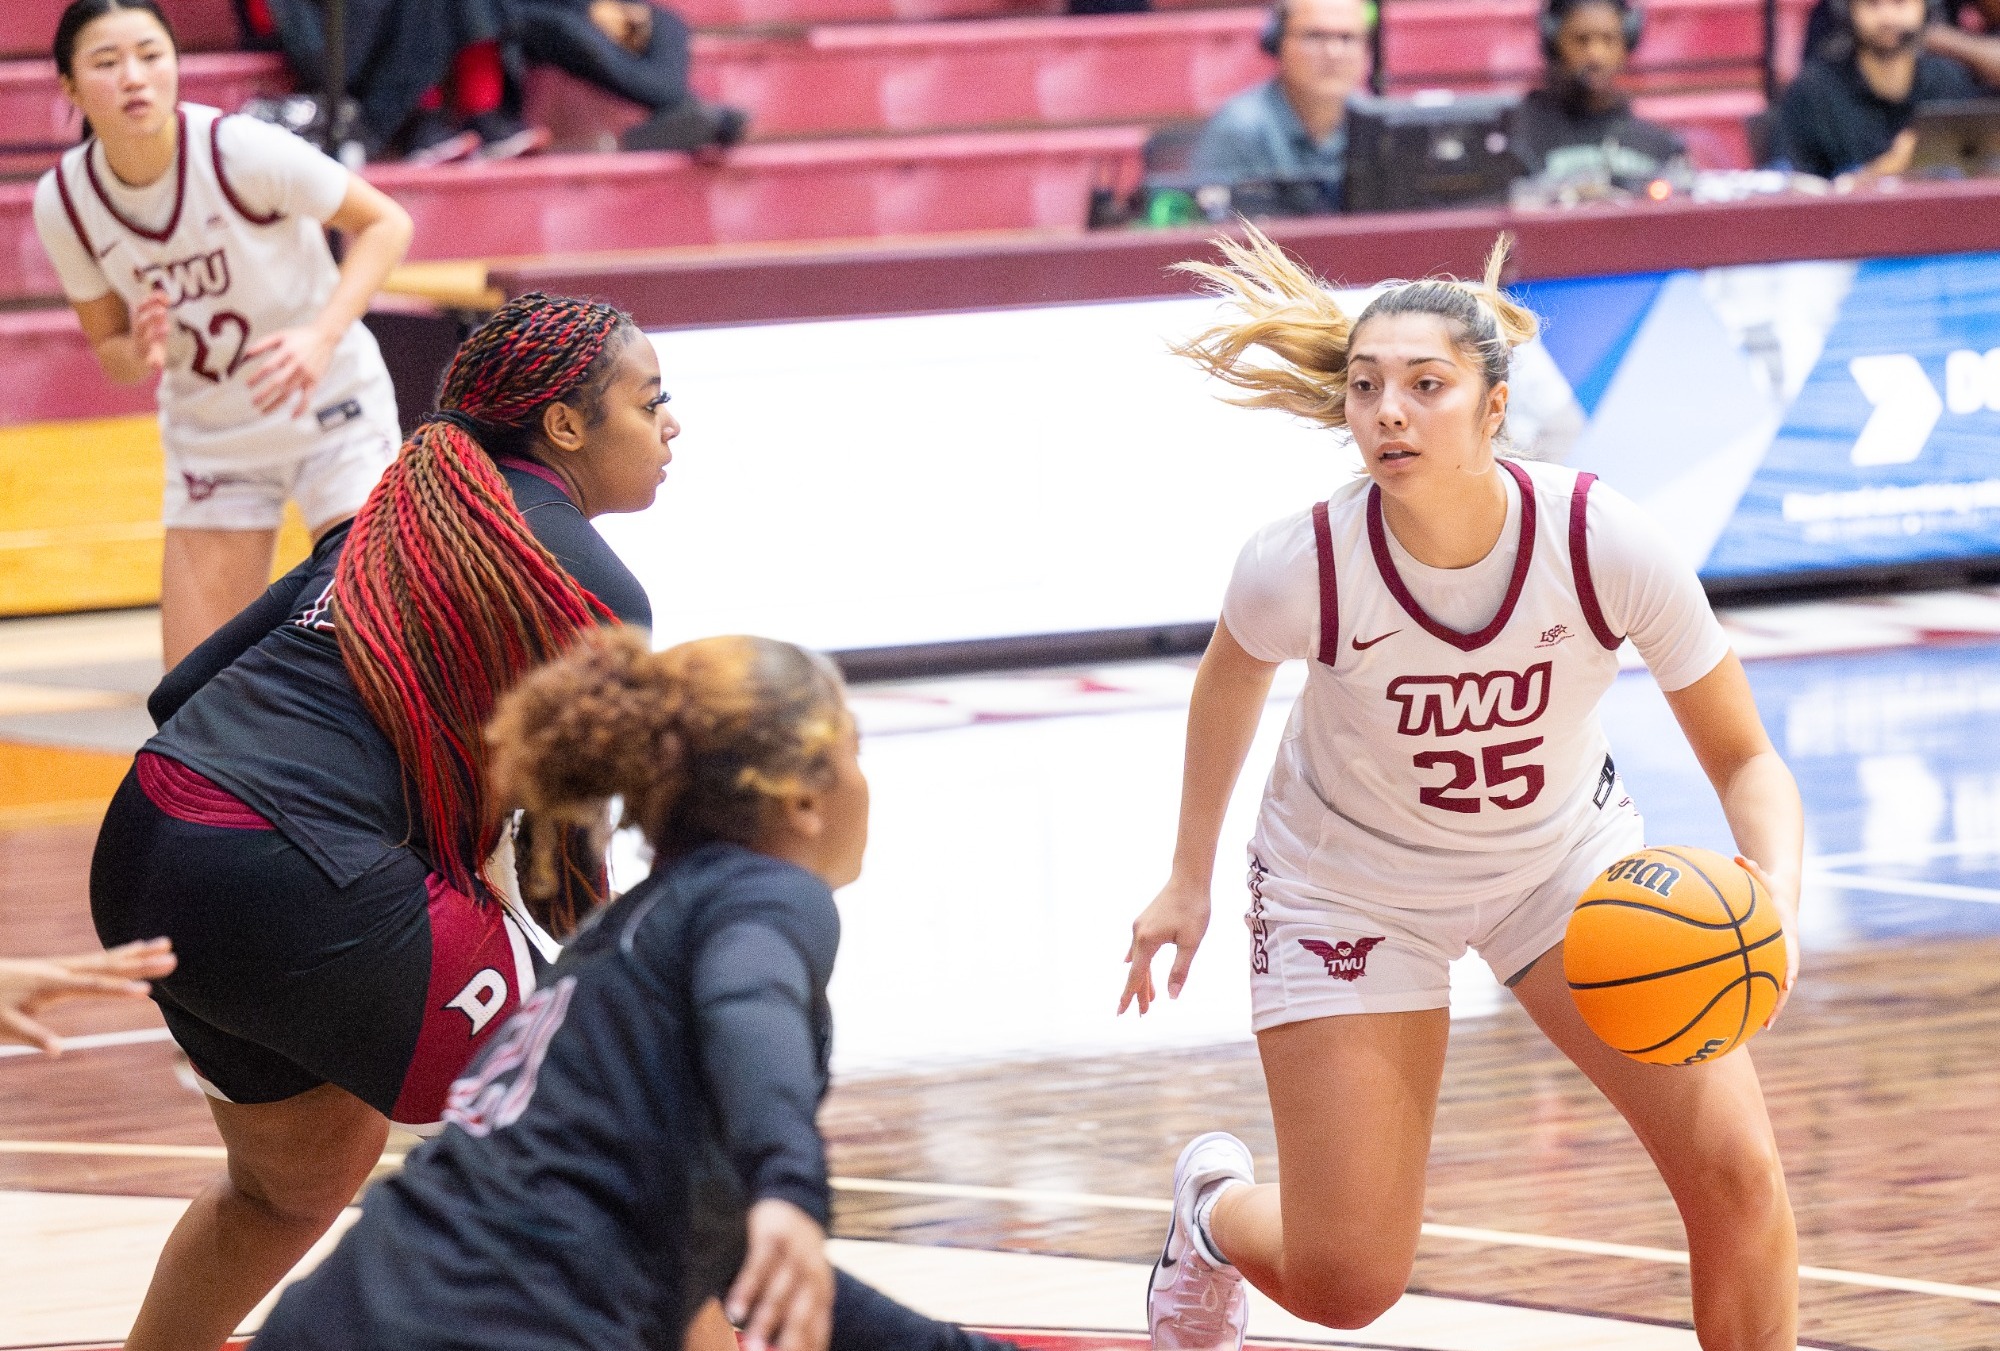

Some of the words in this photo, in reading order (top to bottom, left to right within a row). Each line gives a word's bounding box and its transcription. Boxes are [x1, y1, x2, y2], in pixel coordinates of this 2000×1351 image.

[133, 249, 231, 309] TWU
[176, 310, 250, 384] 22
[1386, 660, 1553, 737] TWU
[1413, 736, 1545, 813] 25
[1328, 957, 1364, 973] TWU
[440, 966, 508, 1040] D
